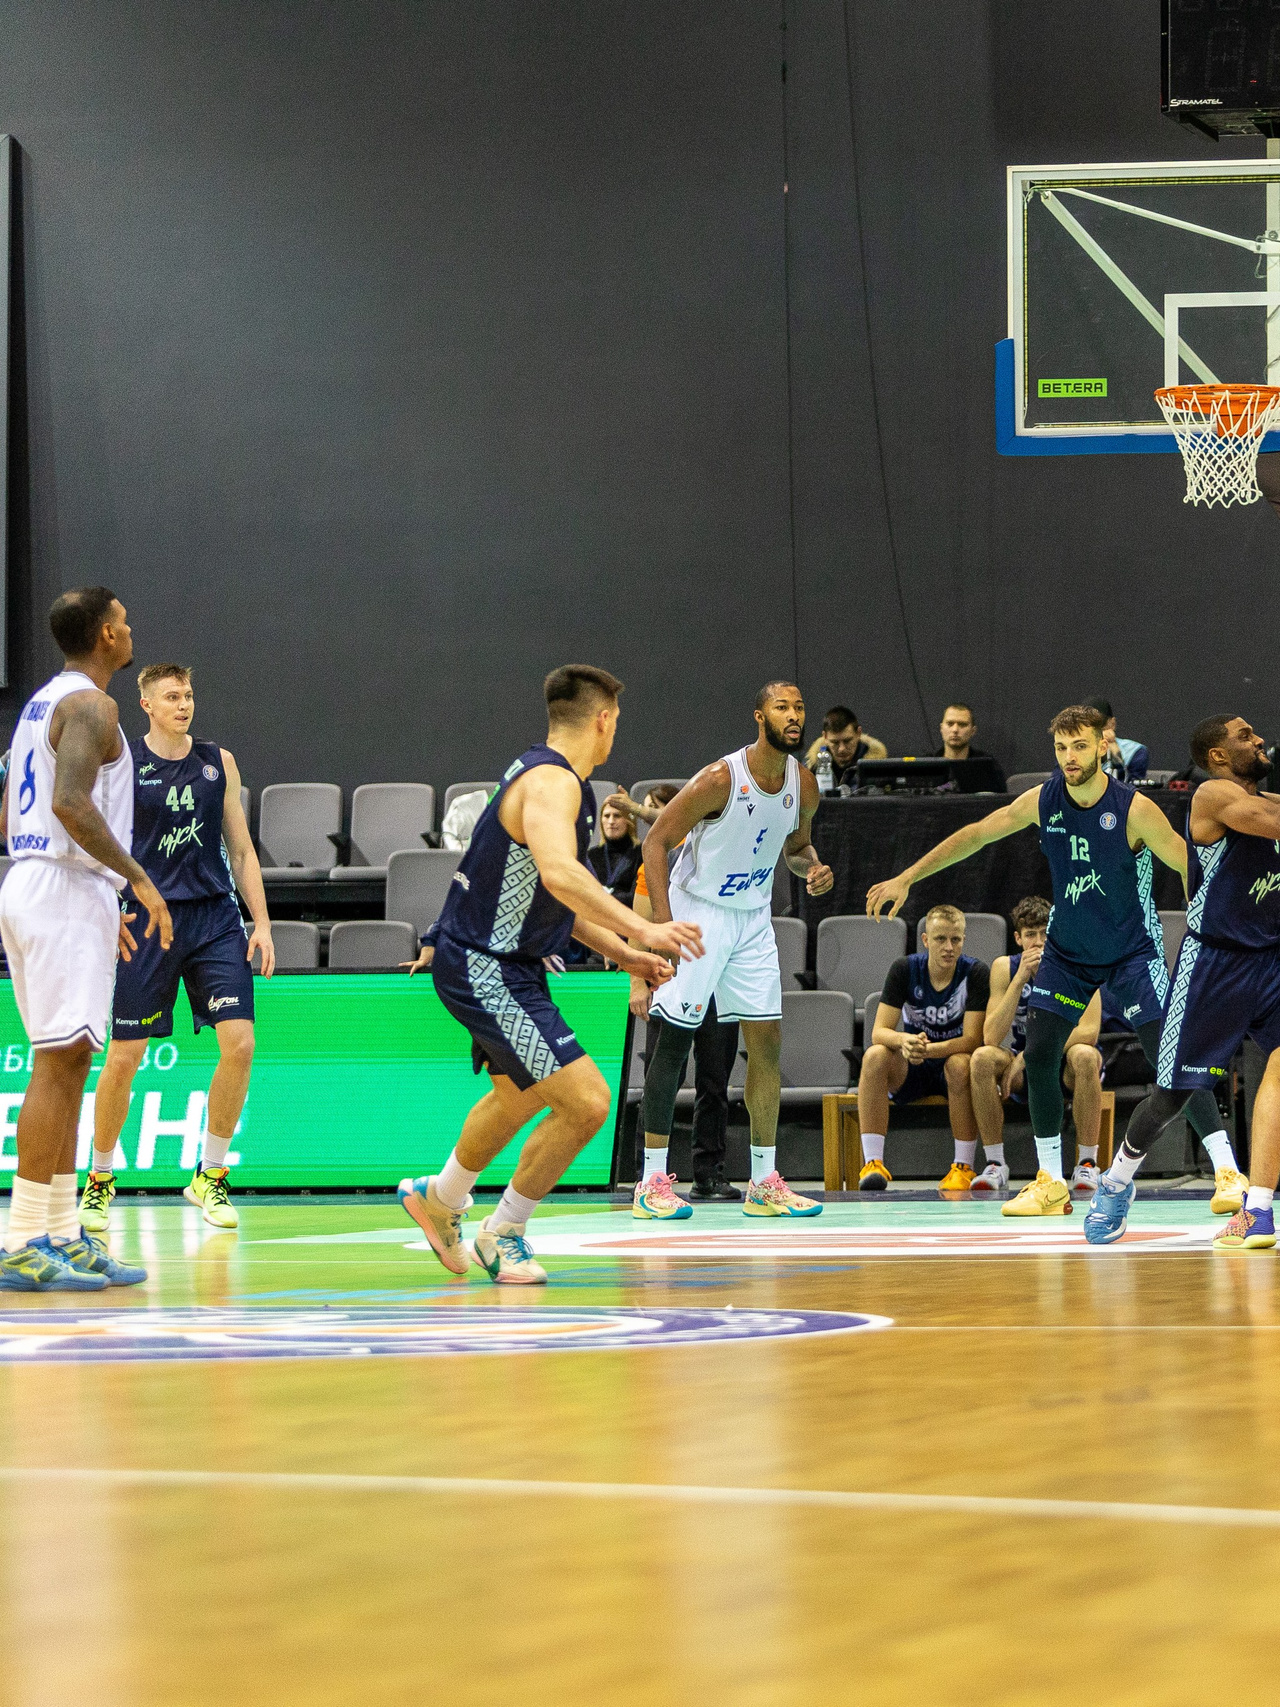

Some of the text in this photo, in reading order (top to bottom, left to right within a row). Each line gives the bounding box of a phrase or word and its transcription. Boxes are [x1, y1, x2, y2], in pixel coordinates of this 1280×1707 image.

[1169, 99, 1224, 107] STRAMATEL
[165, 785, 195, 812] 44
[752, 827, 769, 855] 5
[1069, 834, 1091, 862] 12
[115, 1018, 139, 1027] Kempa
[924, 1005, 949, 1026] 99
[1181, 1064, 1208, 1075] Kempa
